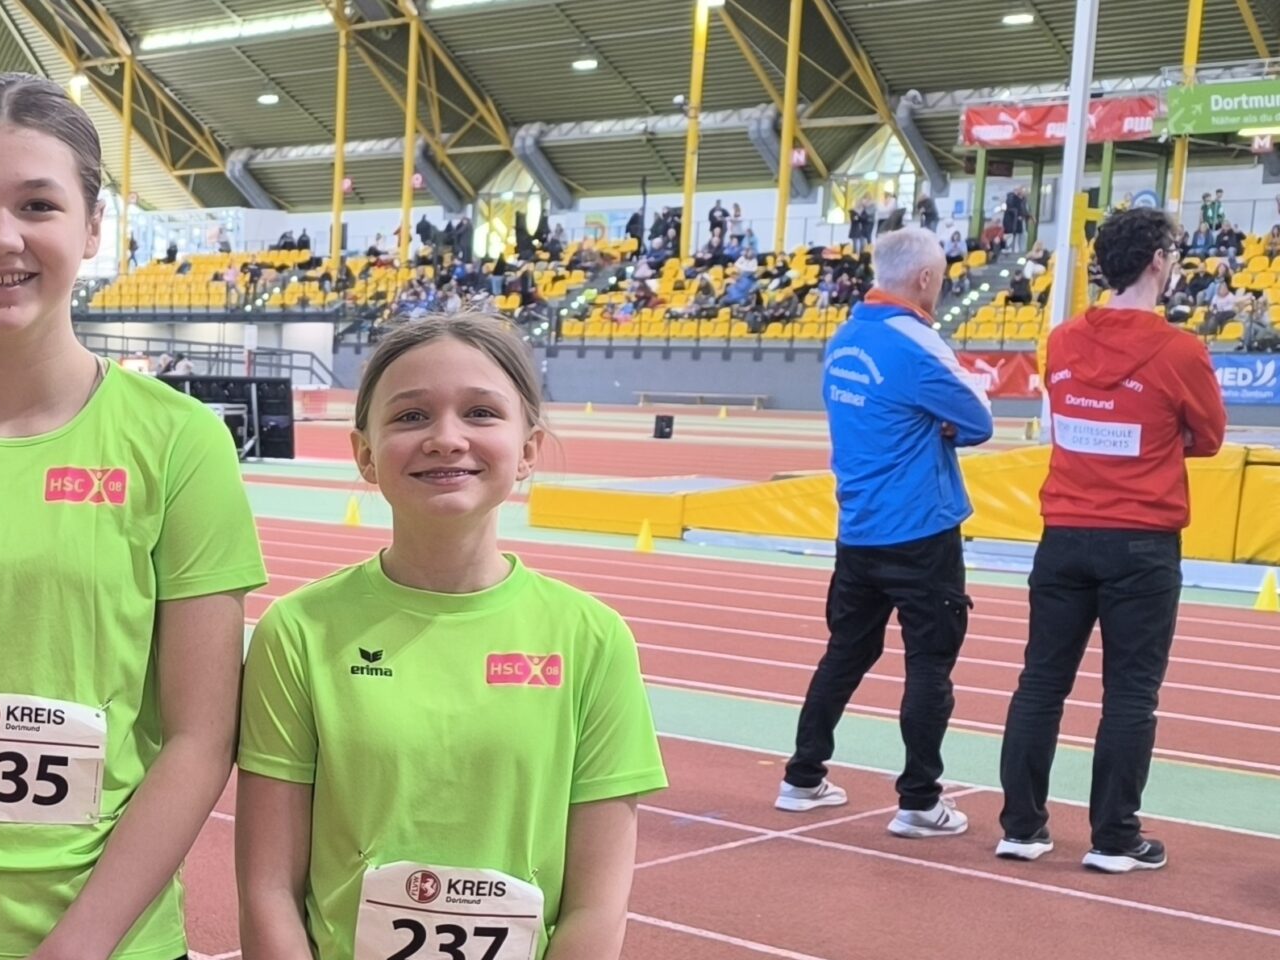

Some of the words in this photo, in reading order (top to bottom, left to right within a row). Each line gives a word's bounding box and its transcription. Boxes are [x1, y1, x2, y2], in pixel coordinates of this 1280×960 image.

[1065, 394, 1115, 410] Dortmund
[1073, 425, 1133, 438] ELITESCHULE
[1072, 435, 1090, 445] DES
[1094, 437, 1130, 449] SPORTS
[50, 476, 85, 493] HSC
[108, 481, 122, 492] 08
[350, 663, 393, 678] erima
[490, 662, 524, 676] HSC
[546, 666, 559, 676] 08
[6, 705, 65, 725] KREIS
[5, 723, 41, 732] Dortmund
[446, 878, 506, 897] KREIS
[445, 896, 481, 905] Dortmund
